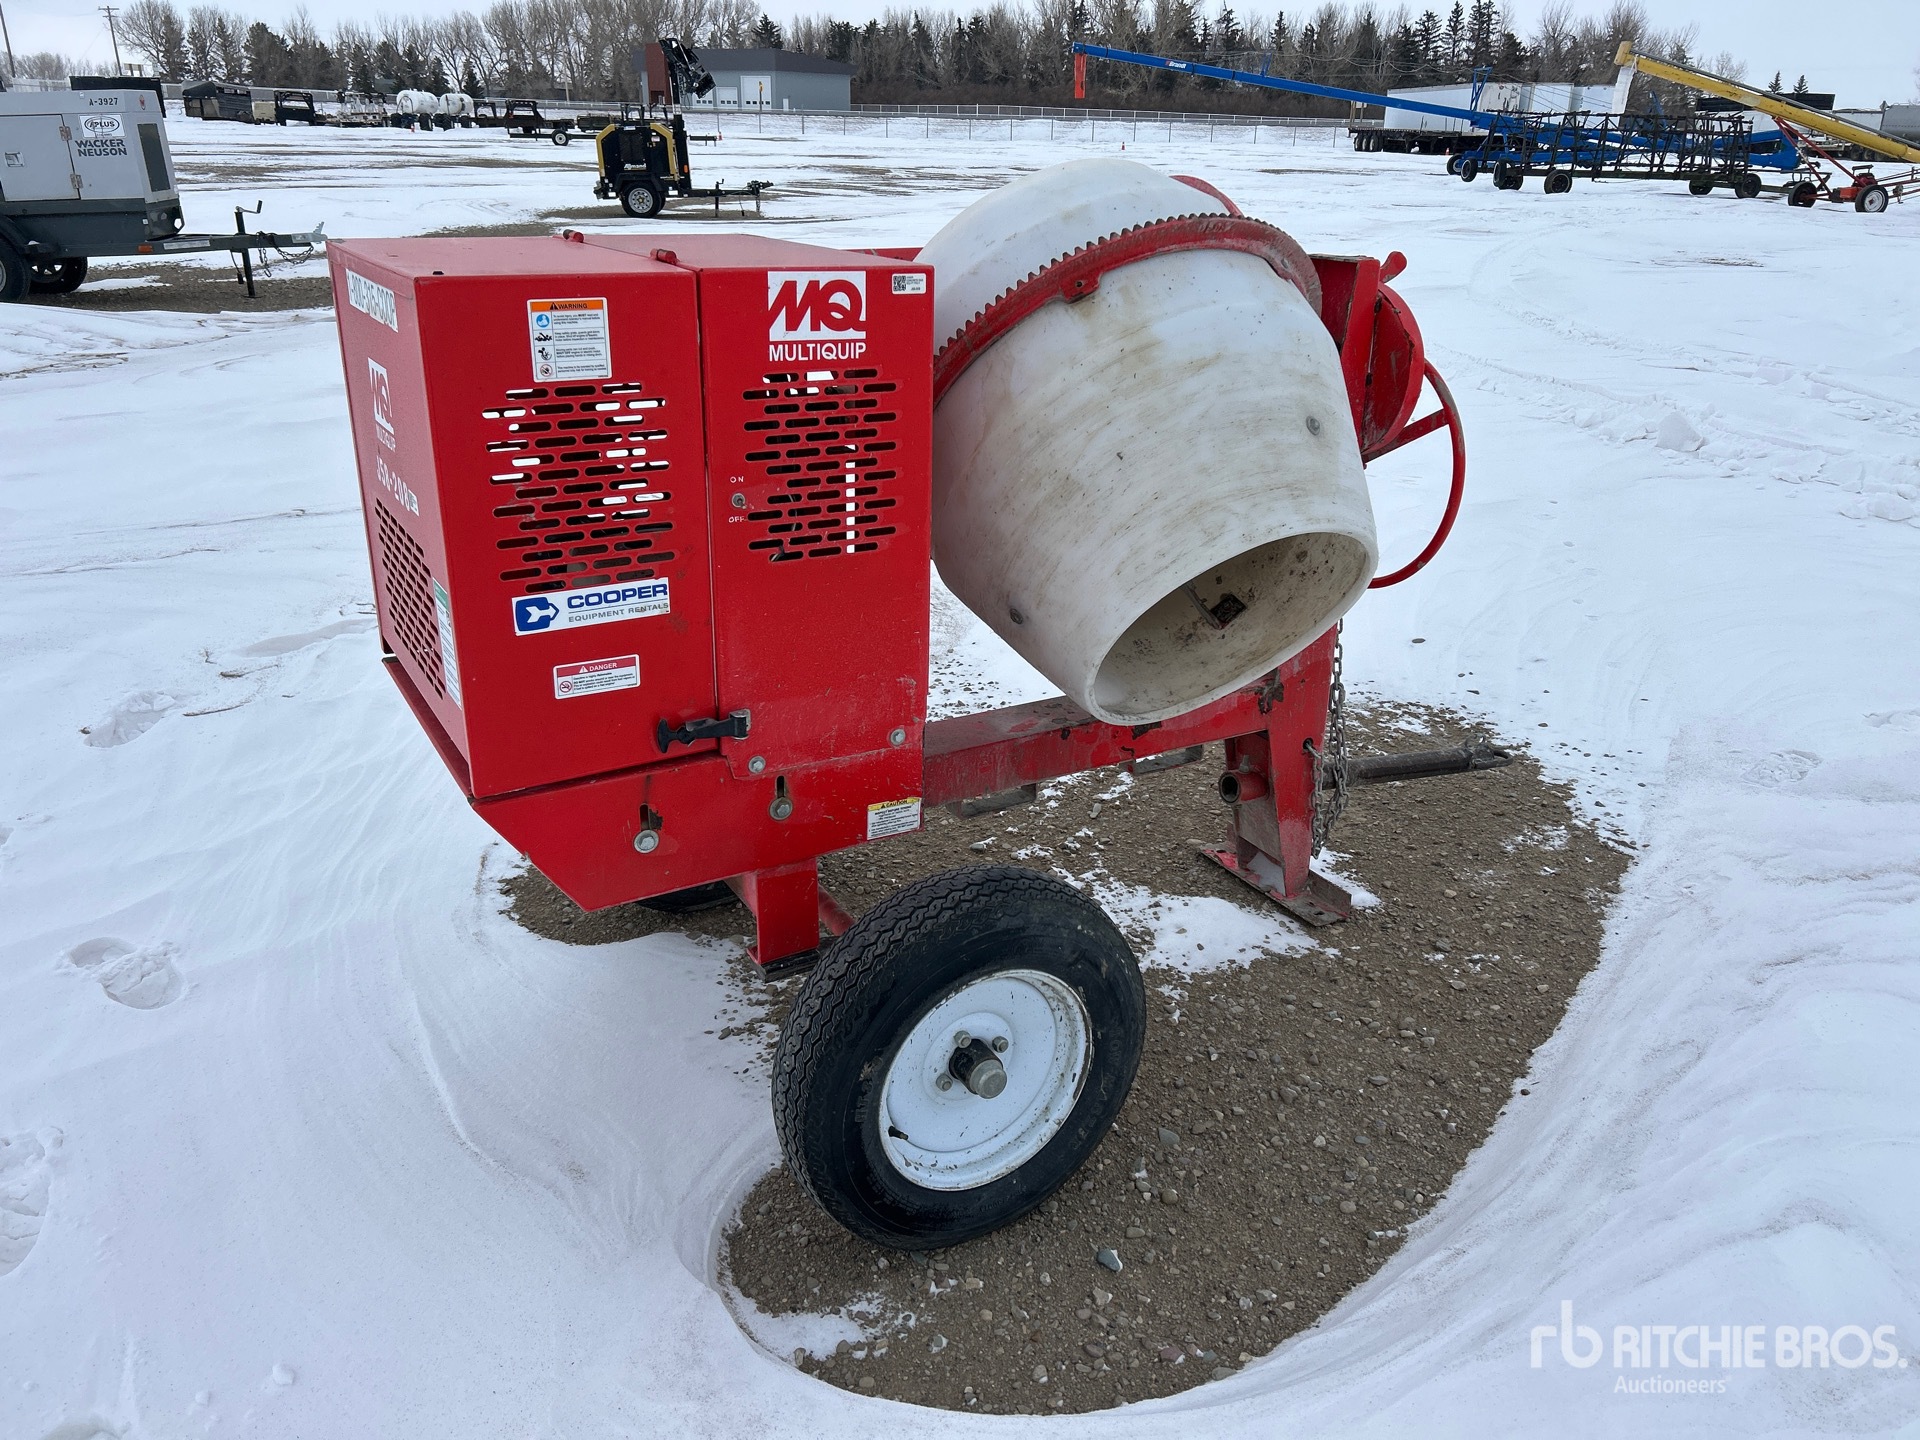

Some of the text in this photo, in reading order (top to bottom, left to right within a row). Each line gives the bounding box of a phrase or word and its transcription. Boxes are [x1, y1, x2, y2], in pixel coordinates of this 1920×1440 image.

[88, 96, 119, 107] A-3927
[75, 138, 126, 148] WACKER
[77, 147, 128, 157] NEUSON
[558, 302, 588, 310] WARNING
[766, 278, 867, 333] MQ
[768, 341, 867, 362] MULTIQUIP
[729, 475, 745, 484] ON
[728, 515, 745, 524] OFF
[567, 583, 668, 609] COOPER
[568, 602, 669, 623] EQUIPMENT RENTALS
[589, 662, 618, 672] DANGER
[885, 799, 908, 808] CAUTION
